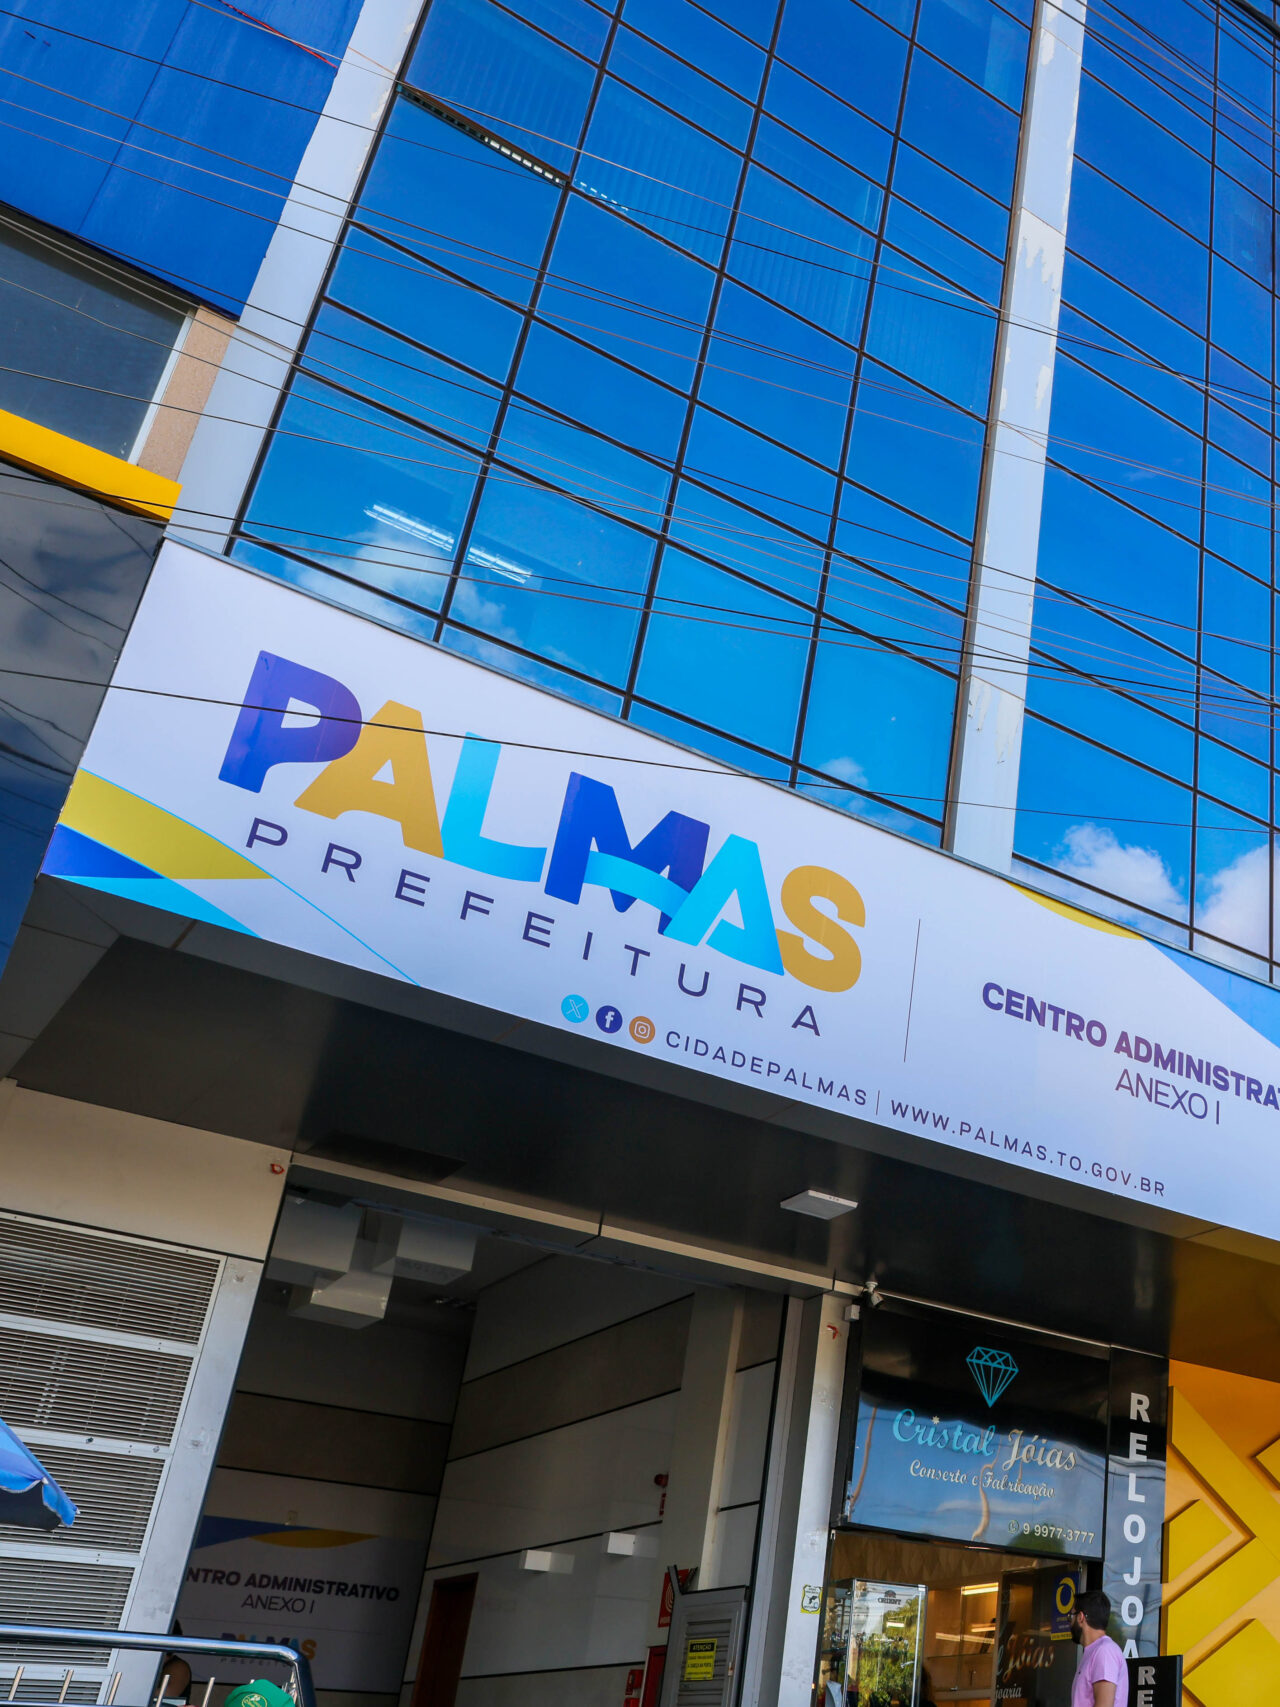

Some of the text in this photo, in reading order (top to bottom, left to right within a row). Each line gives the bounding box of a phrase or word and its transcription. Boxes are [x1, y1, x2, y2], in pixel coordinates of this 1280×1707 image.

[218, 650, 867, 993] PALMAS
[245, 816, 821, 1038] PREFEITURA
[982, 982, 1107, 1048] CENTRO
[665, 1030, 1166, 1198] CIDADEPALMAS WWW.PALMAS.TO.GOV.BR
[1115, 1068, 1208, 1121] ANEXO
[892, 1408, 1078, 1471] Cristal Jóias
[909, 1459, 1055, 1501] Conserto e Fabricação
[1023, 1523, 1095, 1544] 9 9977-3777
[241, 1594, 306, 1614] ANEXO
[244, 1573, 400, 1602] ADMINISTRATIVO
